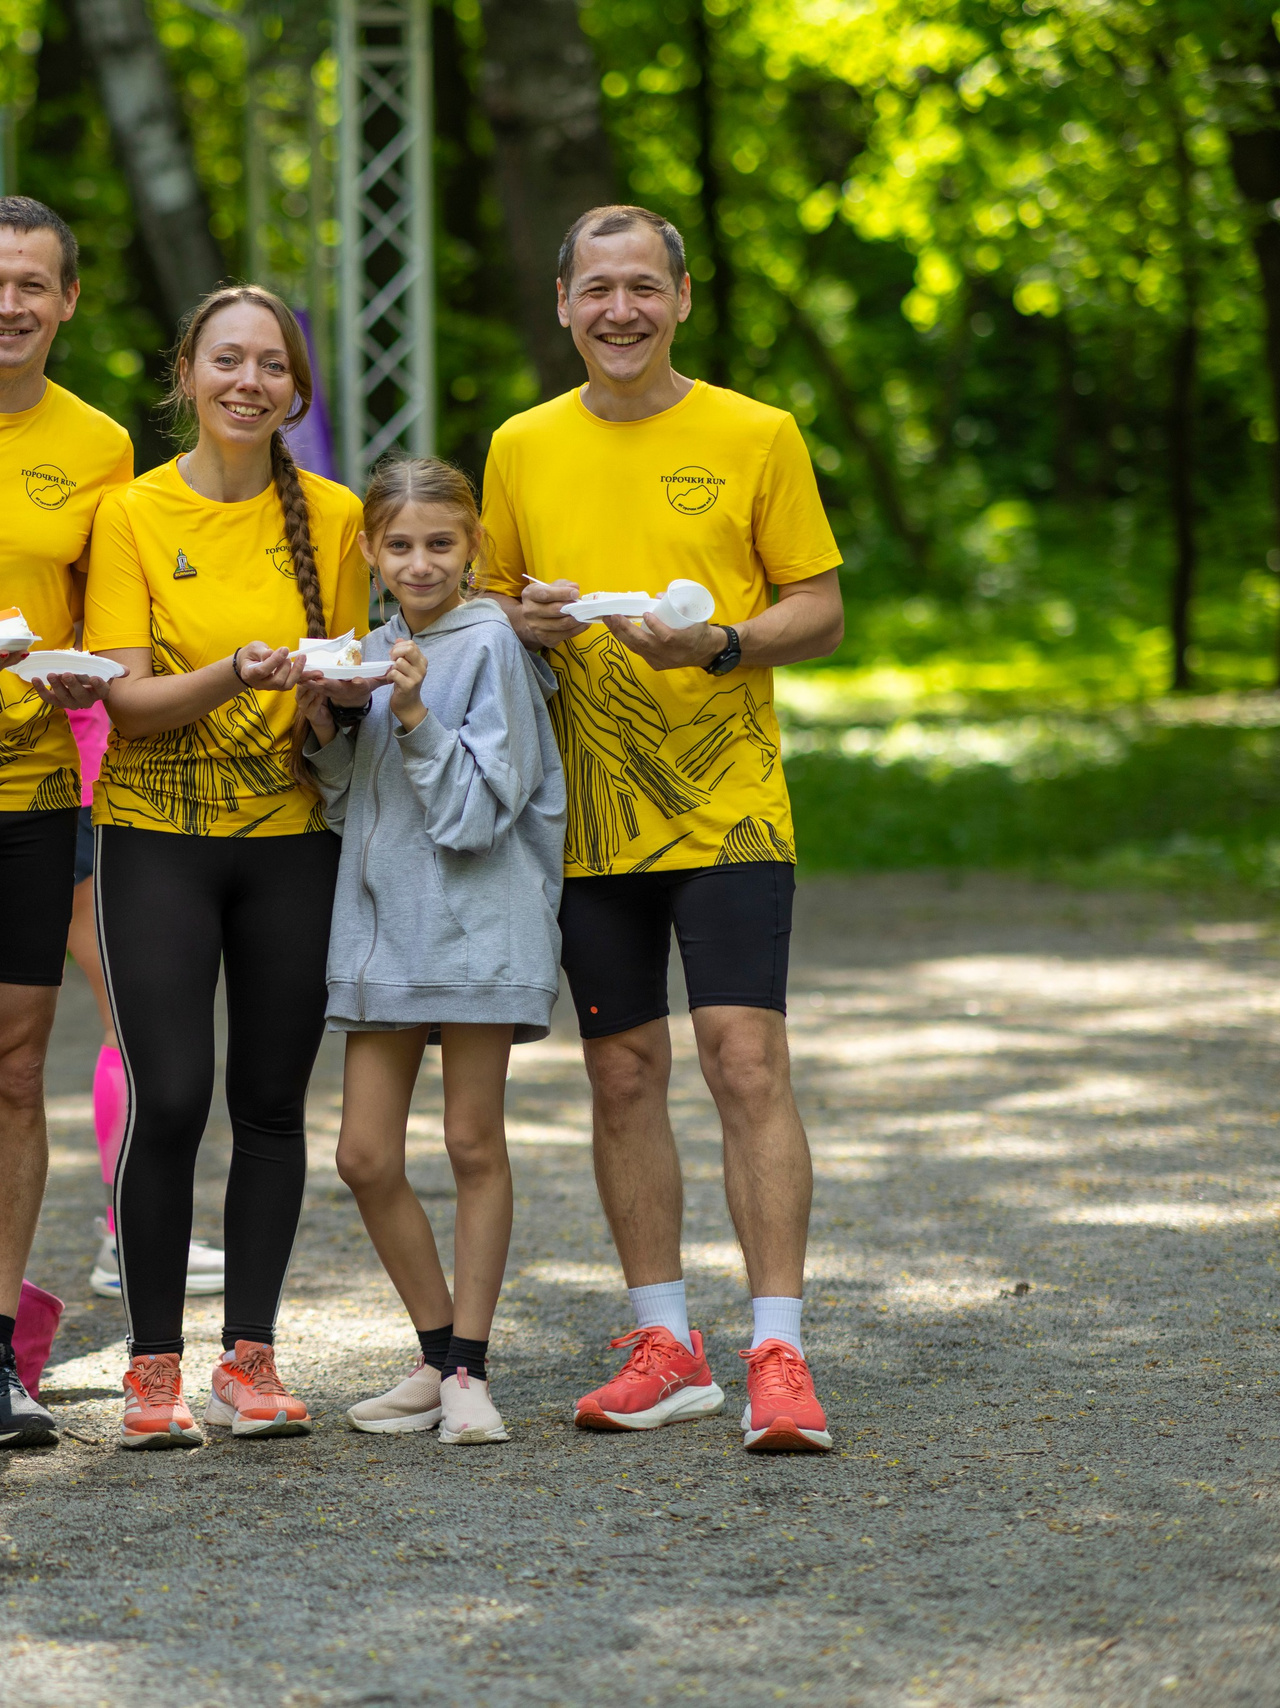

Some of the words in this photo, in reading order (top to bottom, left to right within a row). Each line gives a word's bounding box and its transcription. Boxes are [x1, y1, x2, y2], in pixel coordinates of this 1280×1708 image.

[20, 469, 59, 483] ГОРОЧКИ
[60, 478, 77, 488] RUN
[660, 475, 704, 484] ГОРОЧКИ
[706, 477, 726, 486] RUN
